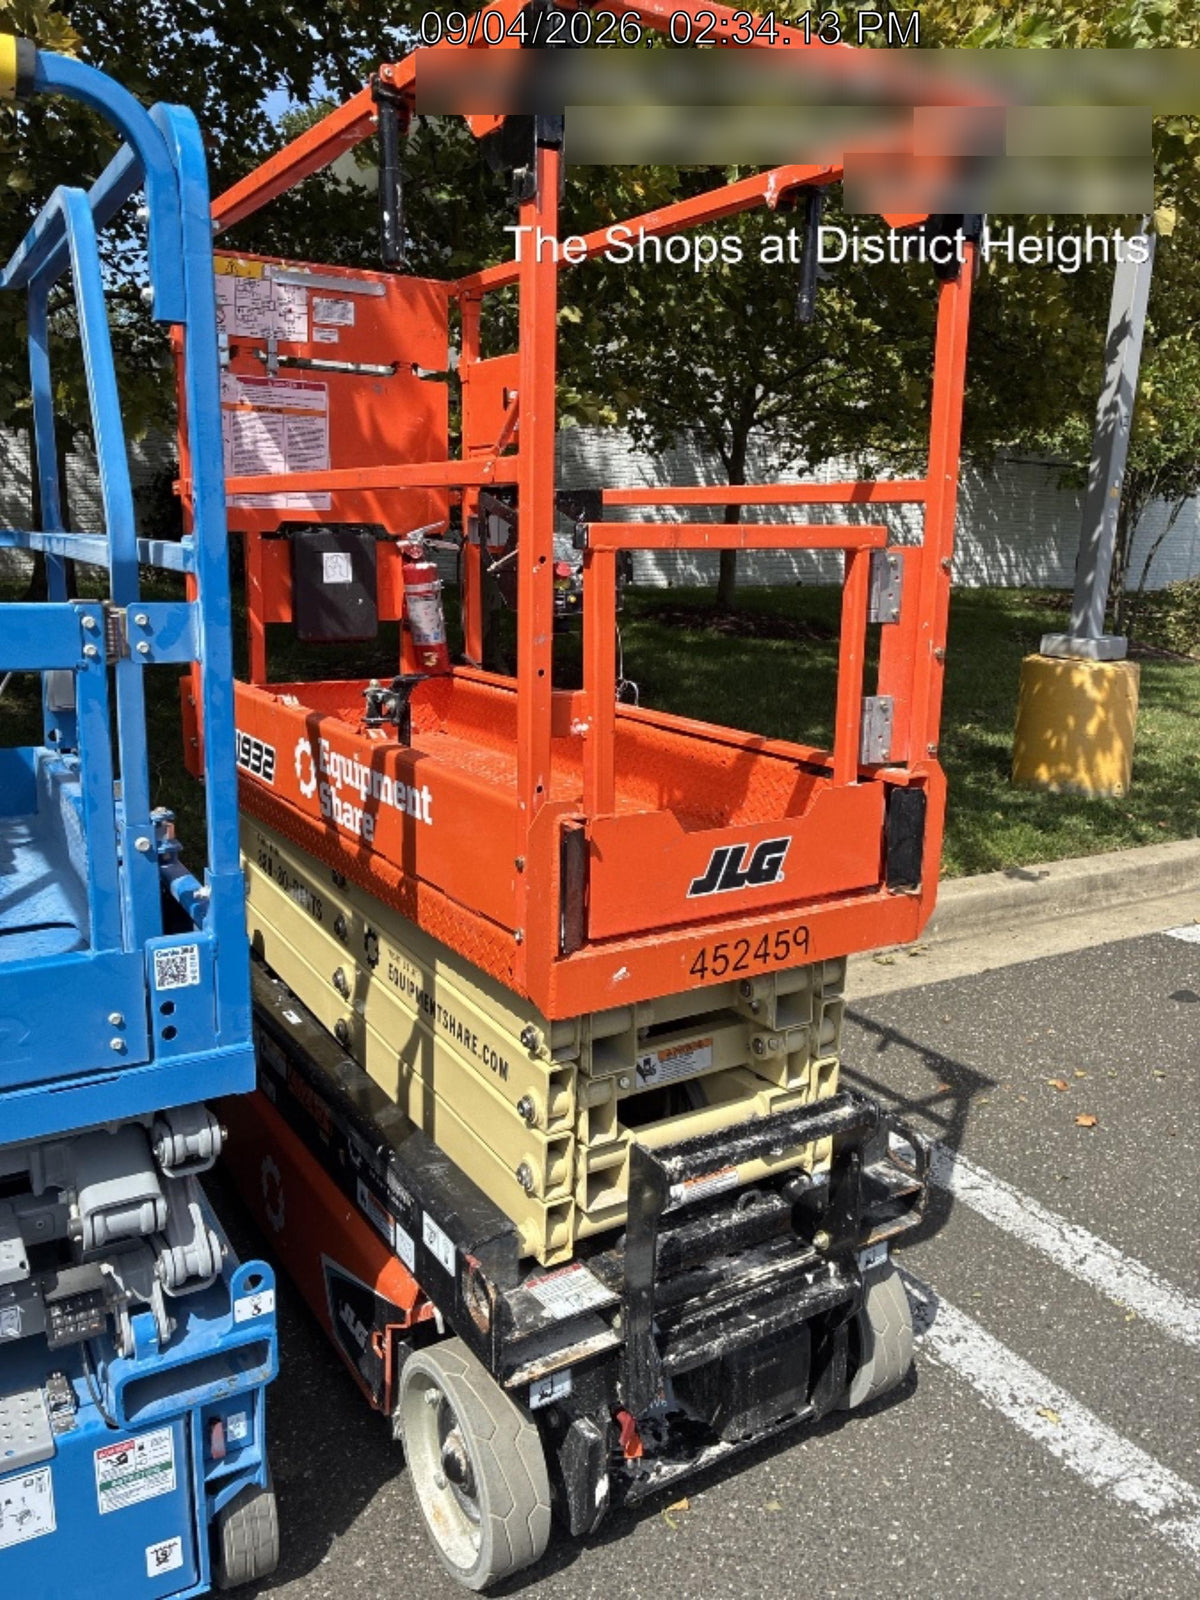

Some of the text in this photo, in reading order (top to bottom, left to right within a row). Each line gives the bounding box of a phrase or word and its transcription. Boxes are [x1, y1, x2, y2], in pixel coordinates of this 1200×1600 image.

[318, 737, 433, 825] Equipment
[319, 781, 375, 842] Share
[686, 836, 792, 898] JLG
[689, 925, 811, 980] 452459
[388, 962, 510, 1082] EQUIPMENTSHARE.COM
